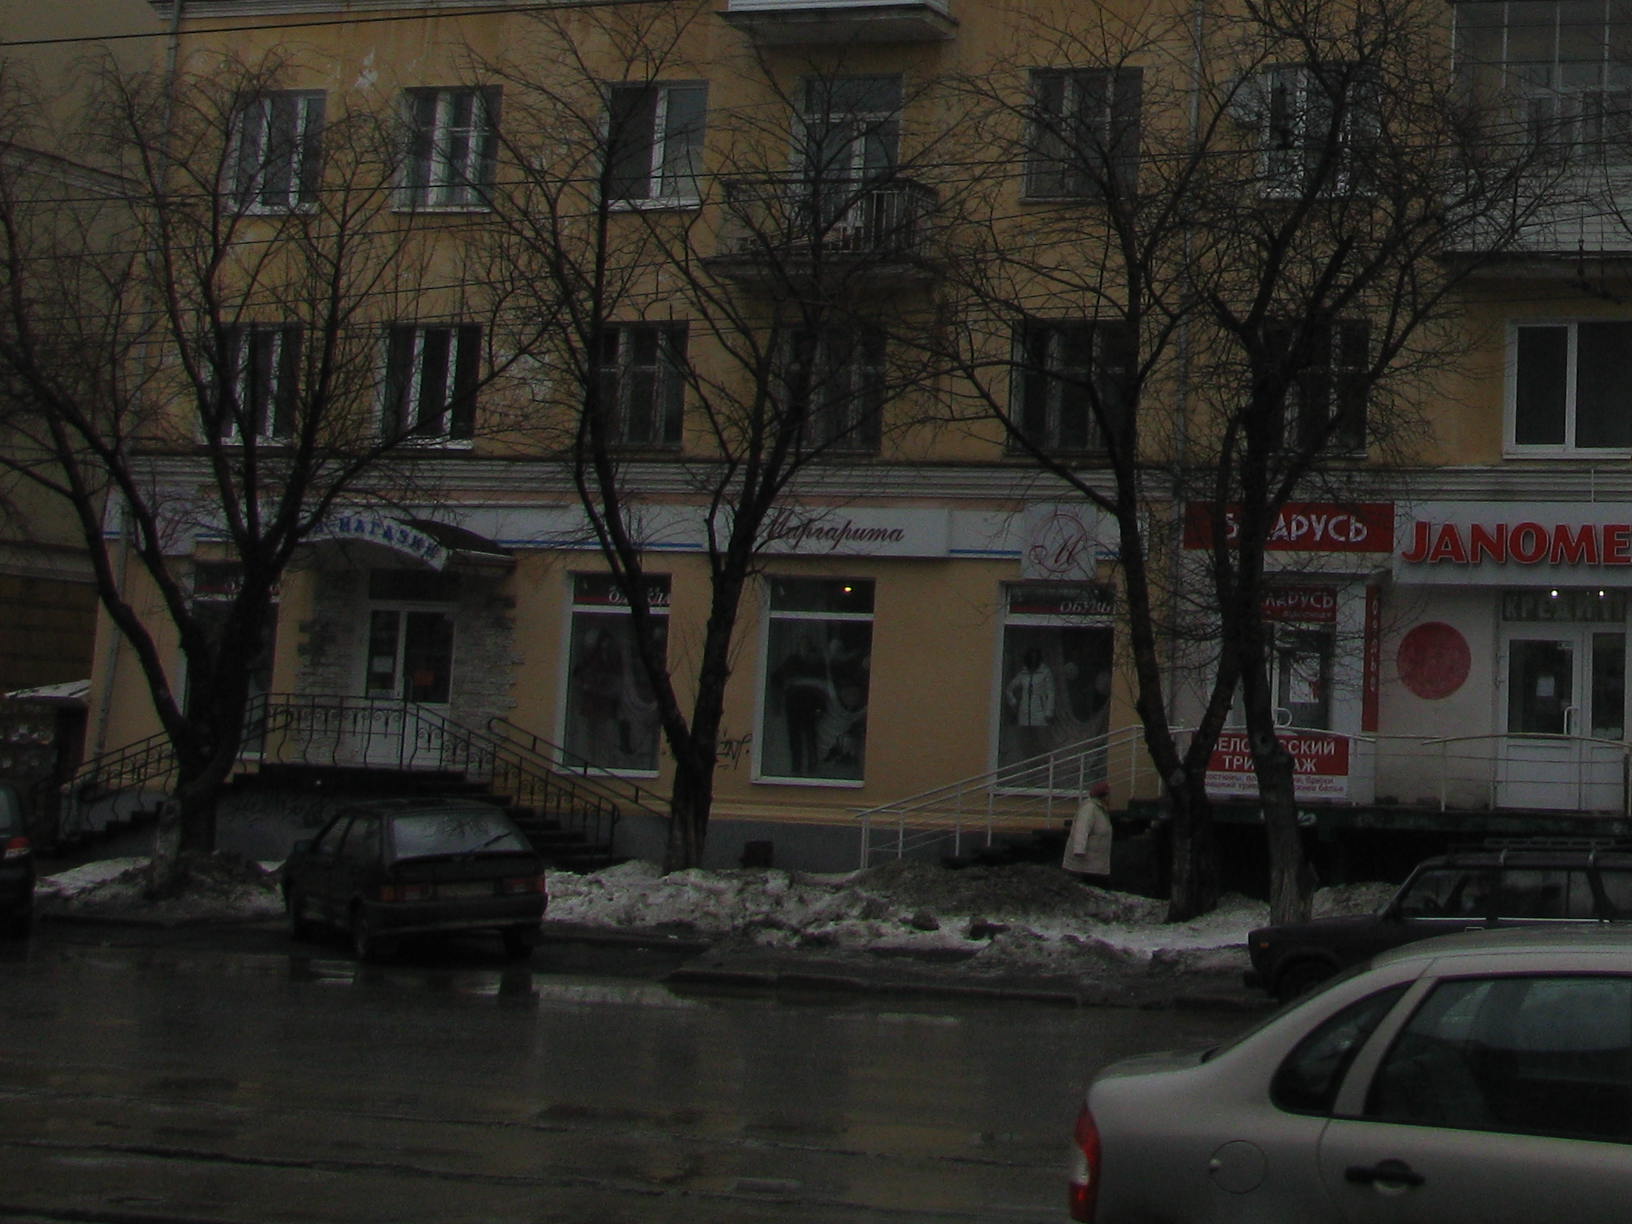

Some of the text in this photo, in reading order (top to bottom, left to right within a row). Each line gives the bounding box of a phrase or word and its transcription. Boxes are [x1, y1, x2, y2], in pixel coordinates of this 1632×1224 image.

[766, 508, 905, 550] Маргарита
[1220, 511, 1368, 544] БАРУСЬ
[1212, 737, 1336, 756] ЕЛОСКИЙ
[1222, 755, 1318, 773] ТРИАЖ
